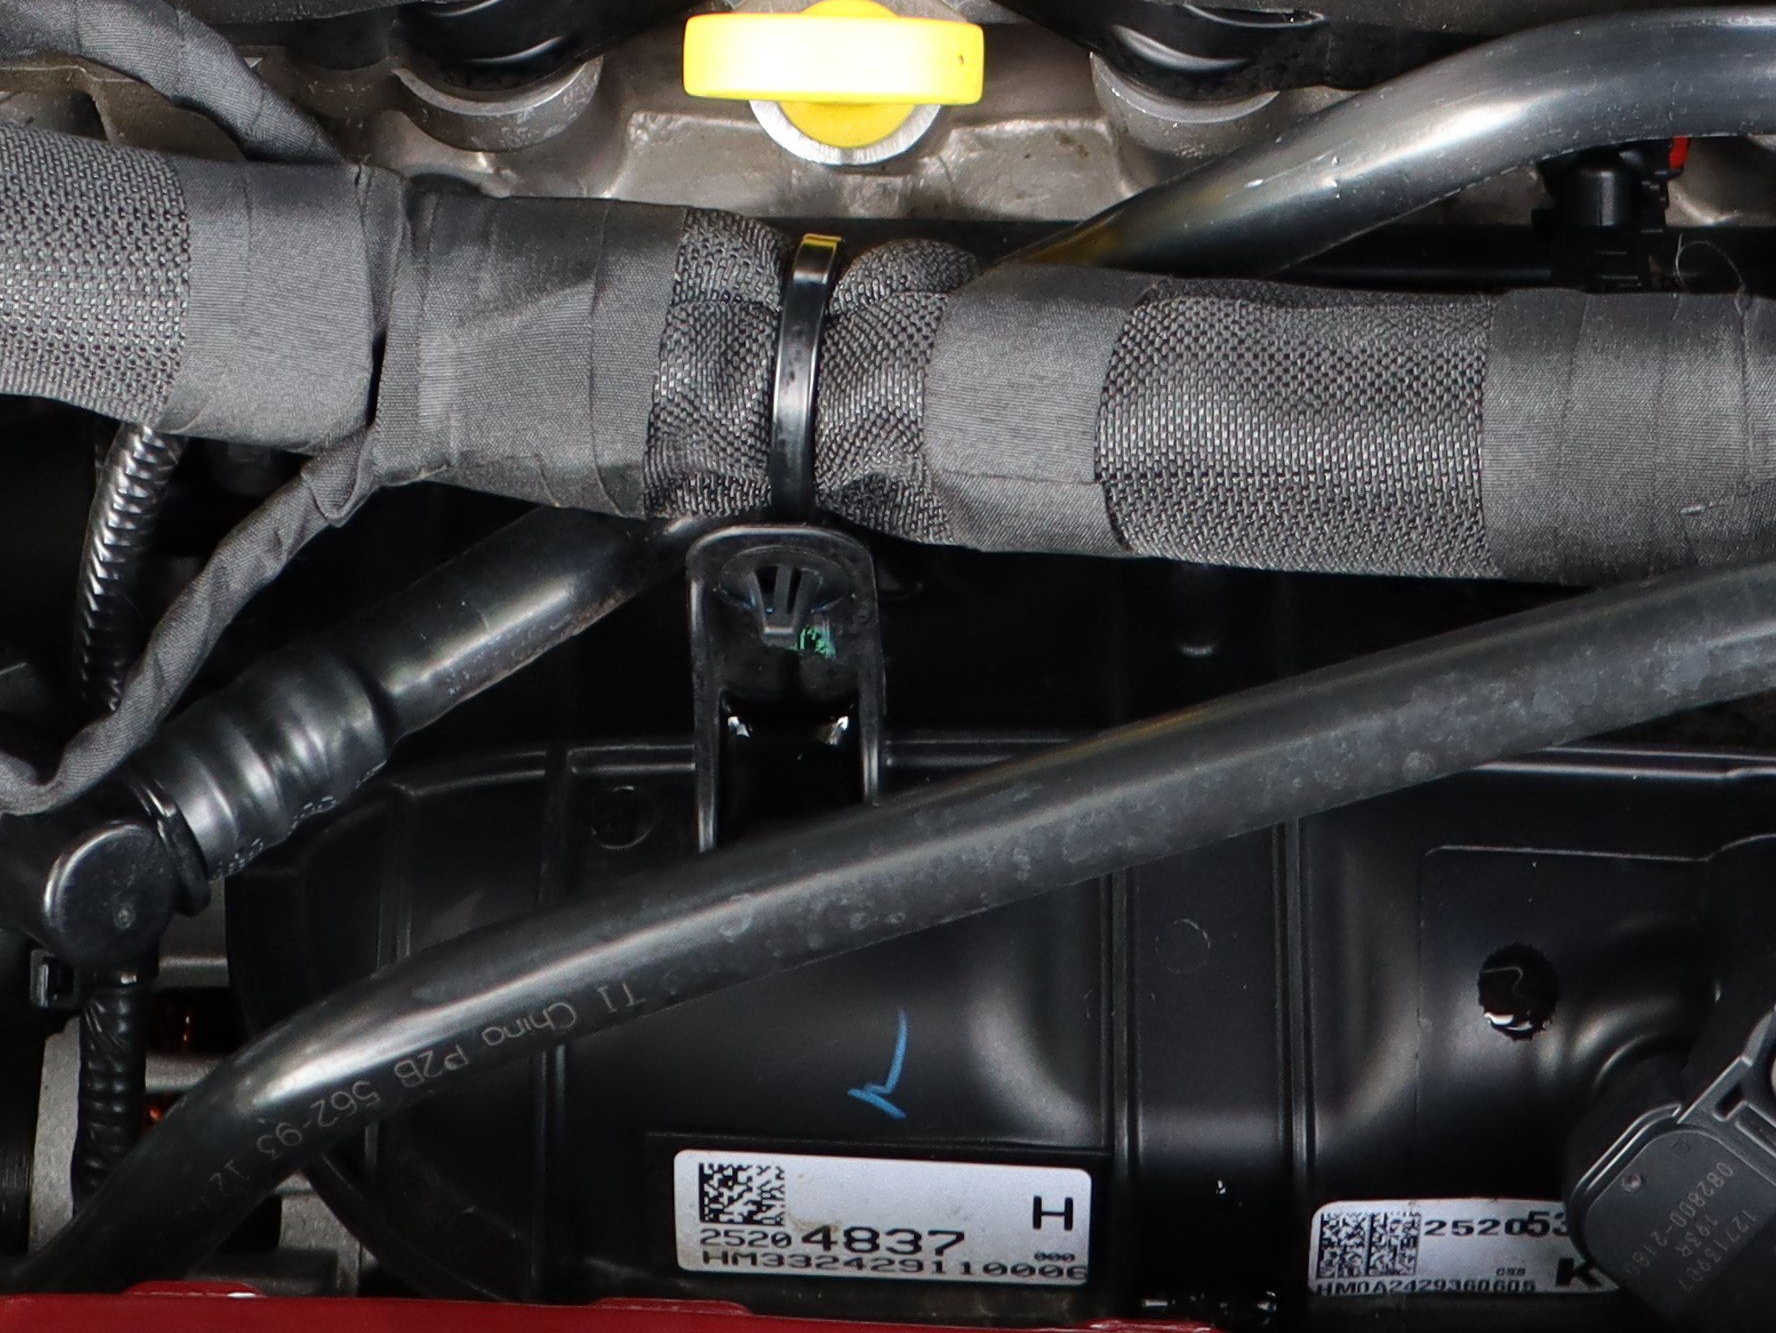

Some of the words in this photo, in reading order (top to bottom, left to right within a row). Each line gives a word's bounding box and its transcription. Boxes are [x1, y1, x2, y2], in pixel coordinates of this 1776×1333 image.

[482, 1001, 578, 1048] China
[393, 1044, 469, 1090] P2B
[256, 1082, 380, 1156] 562-93
[1031, 1195, 1075, 1232] H
[701, 1250, 1089, 1282] HM332429110006
